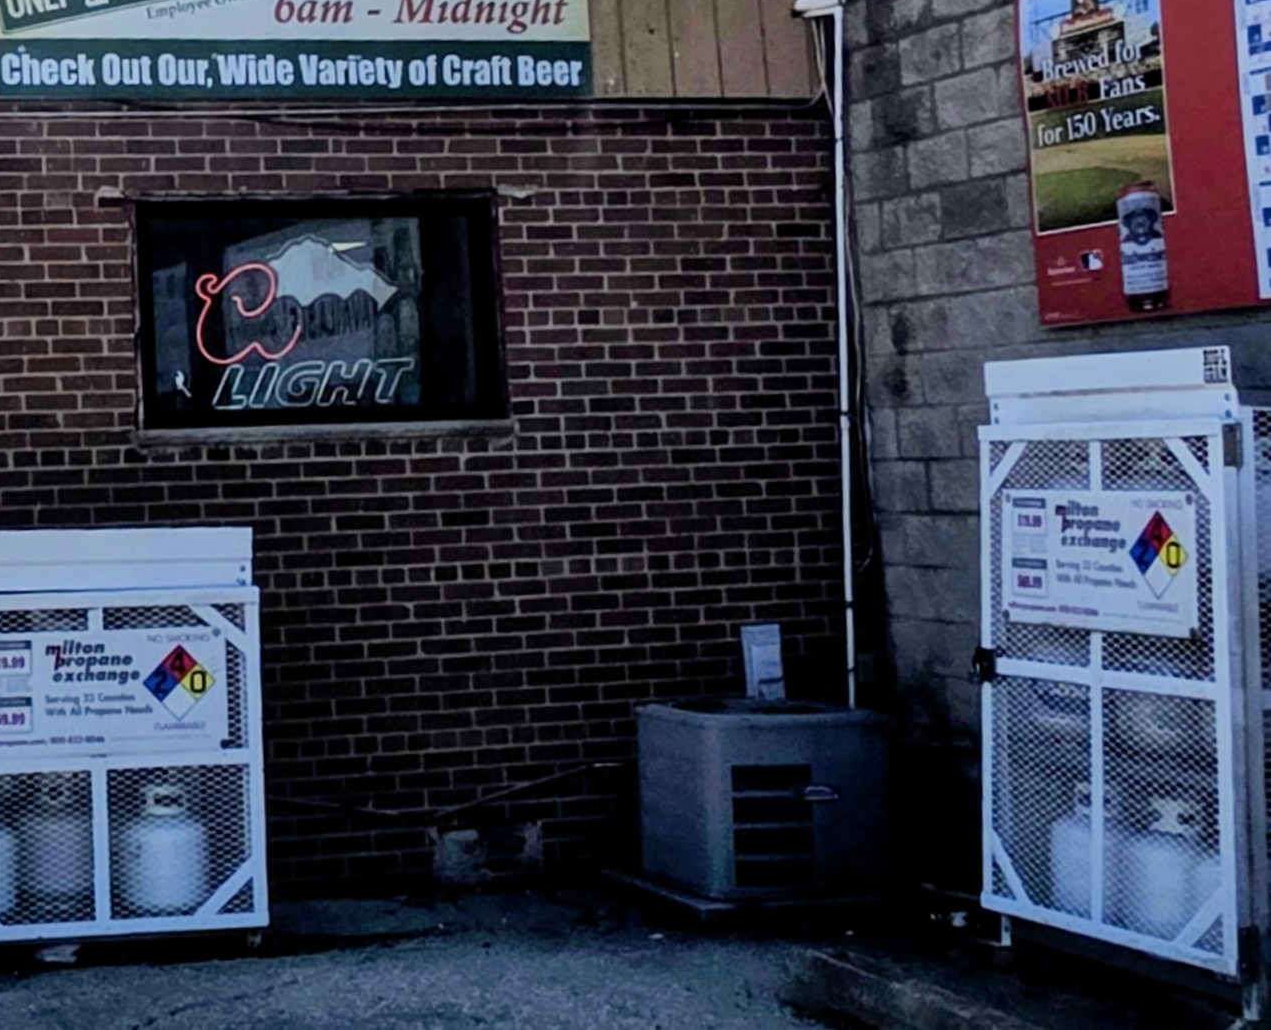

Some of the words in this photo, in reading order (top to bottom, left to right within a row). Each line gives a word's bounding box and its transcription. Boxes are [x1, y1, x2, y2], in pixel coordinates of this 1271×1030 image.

[146, 0, 211, 20] Employee
[1041, 41, 1109, 83] Brewed
[1115, 39, 1141, 63] for
[1, 53, 96, 85] Check
[102, 53, 152, 85] Out
[217, 54, 294, 86] Wide
[298, 54, 403, 89] Variety
[408, 54, 437, 86] of
[442, 54, 511, 86] Craft
[518, 56, 582, 86] Beer
[1098, 75, 1146, 100] Fans
[1037, 123, 1064, 147] for
[1067, 111, 1097, 142] 150
[1100, 104, 1161, 133] Years.
[212, 357, 415, 410] LIGHT
[1055, 500, 1099, 517] milton
[1061, 517, 1121, 534] propane
[1061, 535, 1126, 553] exchange
[1166, 541, 1181, 569] 0
[45, 640, 105, 656] milton
[147, 634, 162, 644] NO
[165, 633, 211, 643] SMOKING
[54, 654, 133, 671] propane
[169, 651, 186, 672] 4
[52, 668, 140, 685] exchange
[153, 674, 166, 693] 2
[190, 670, 207, 694] 0
[45, 693, 79, 706] Serving
[97, 692, 136, 703] Counties
[45, 706, 67, 717] With
[84, 706, 123, 718] Propane
[125, 704, 153, 716] Needs
